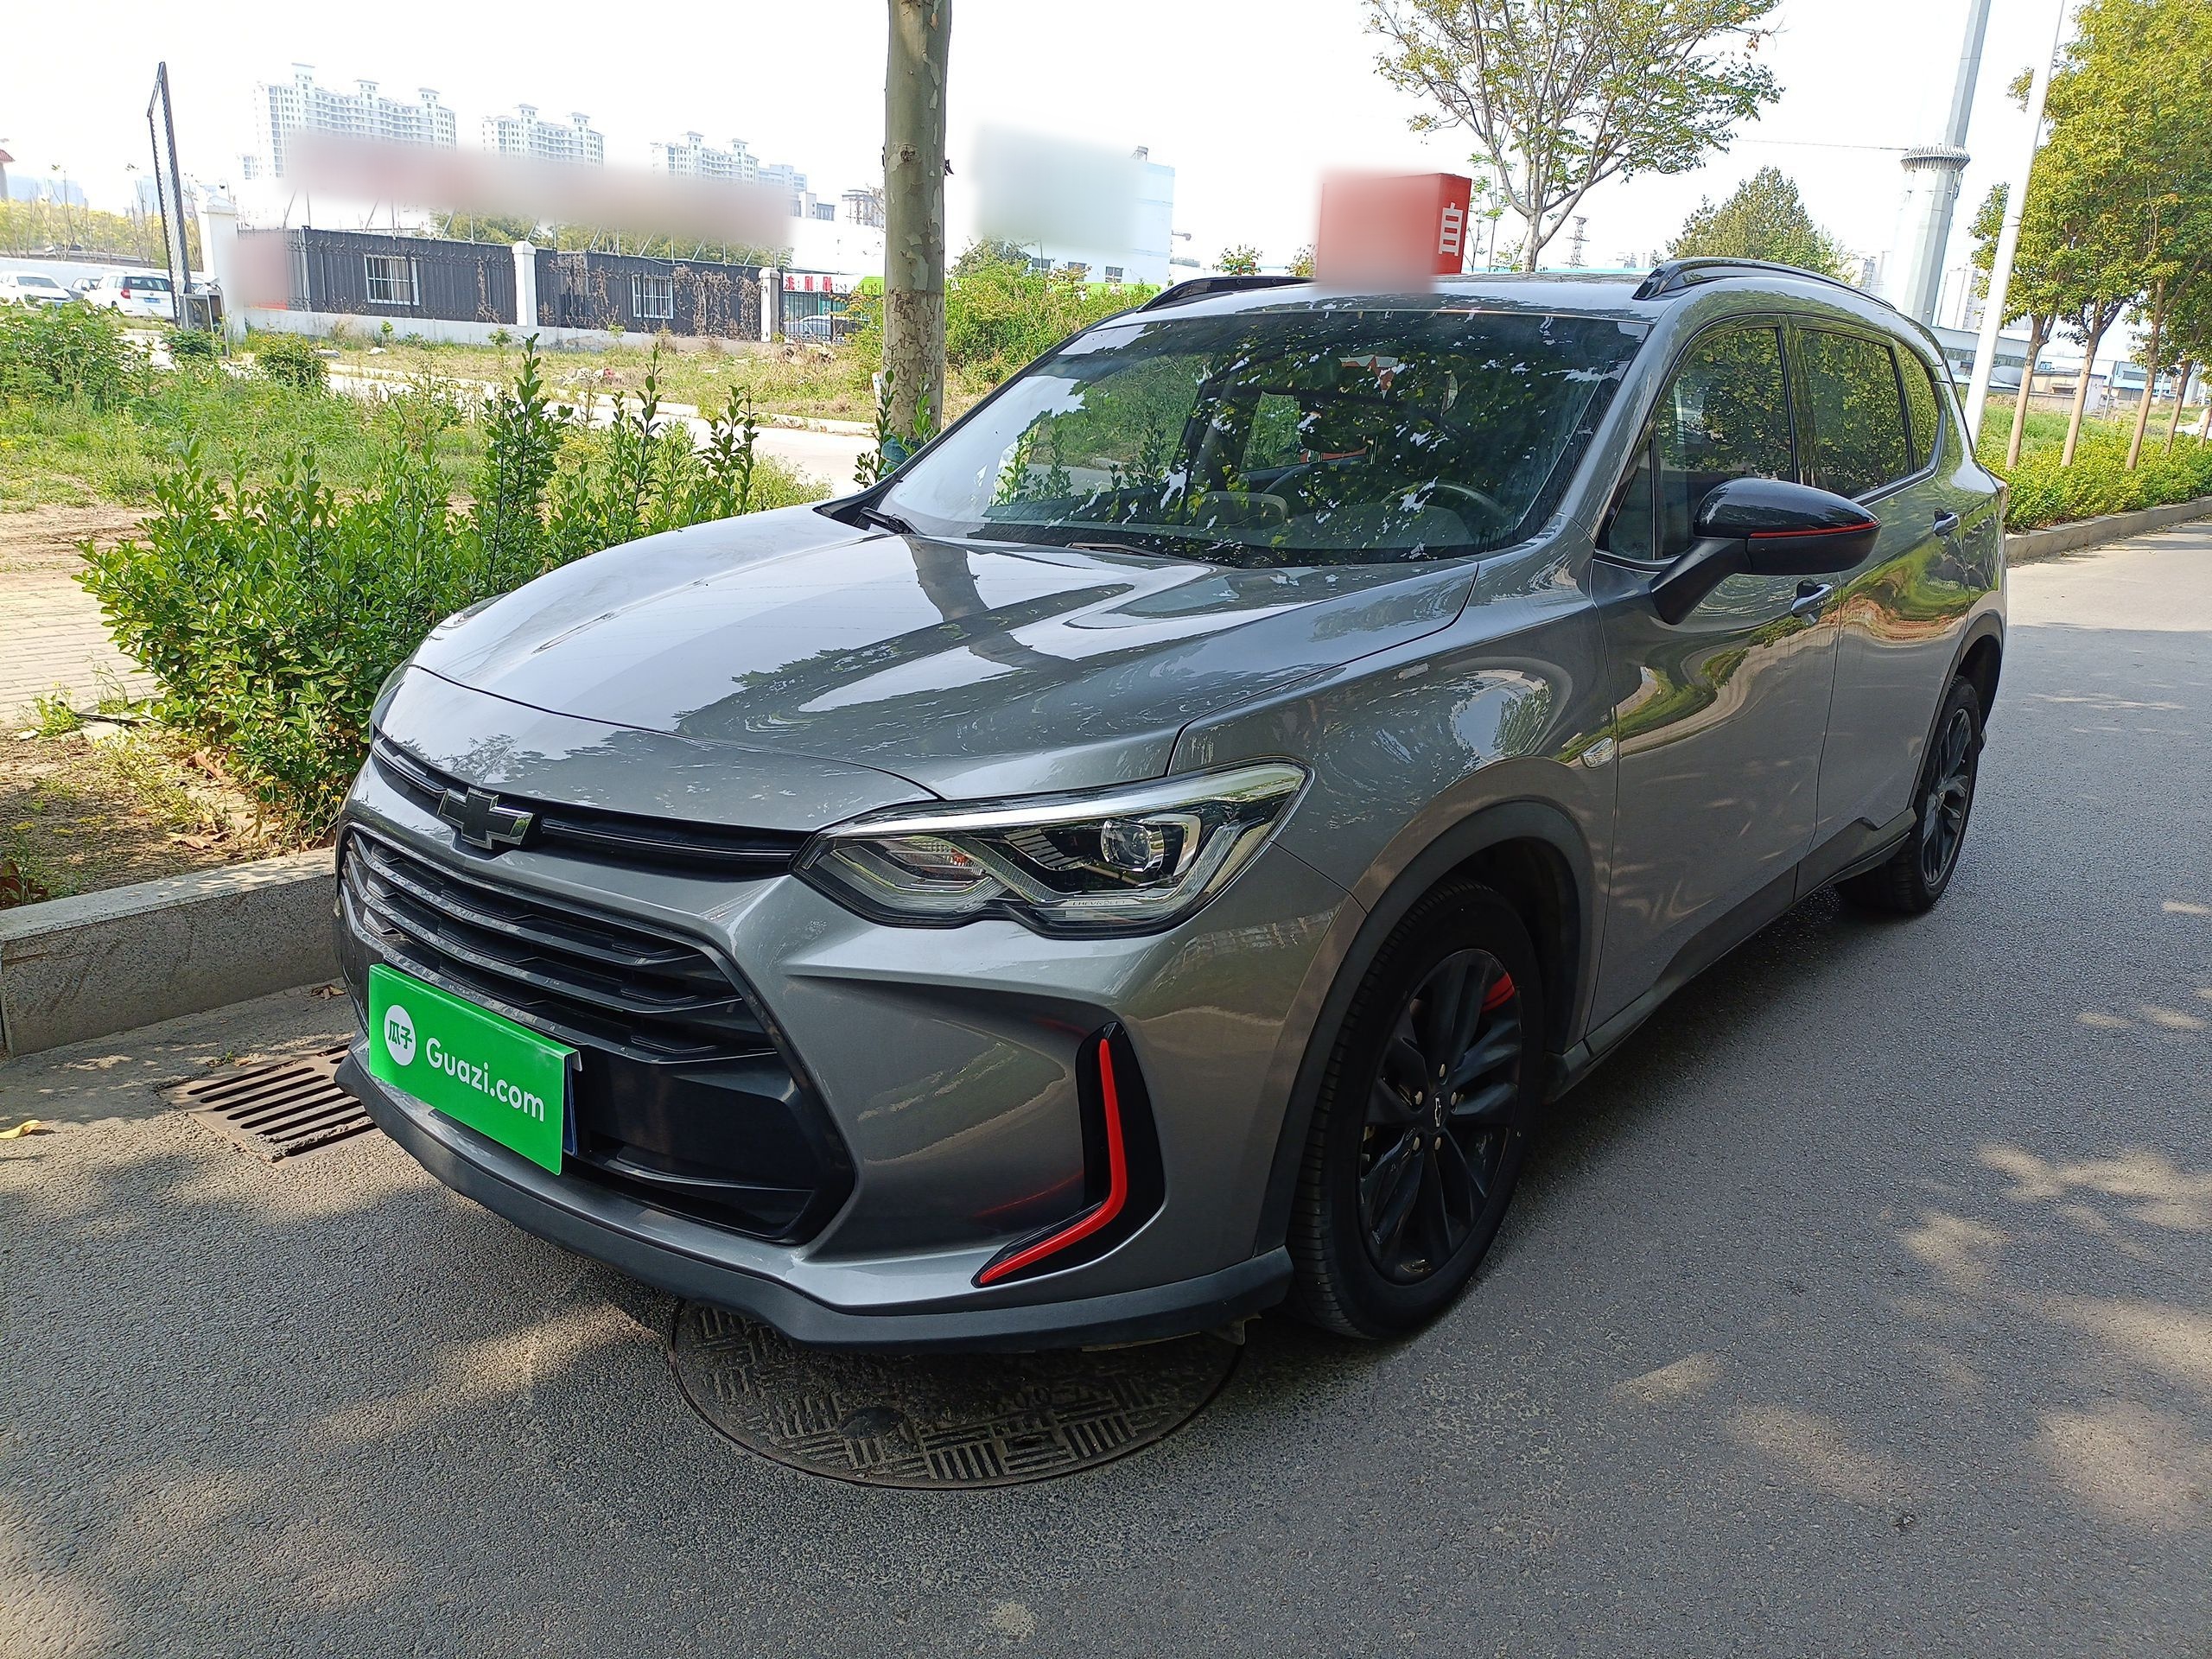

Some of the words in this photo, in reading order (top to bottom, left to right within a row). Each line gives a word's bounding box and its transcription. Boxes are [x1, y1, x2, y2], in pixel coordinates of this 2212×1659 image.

[1438, 201, 1464, 257] 自
[388, 1020, 413, 1050] 瓜子
[426, 1037, 544, 1122] Guazi.com
